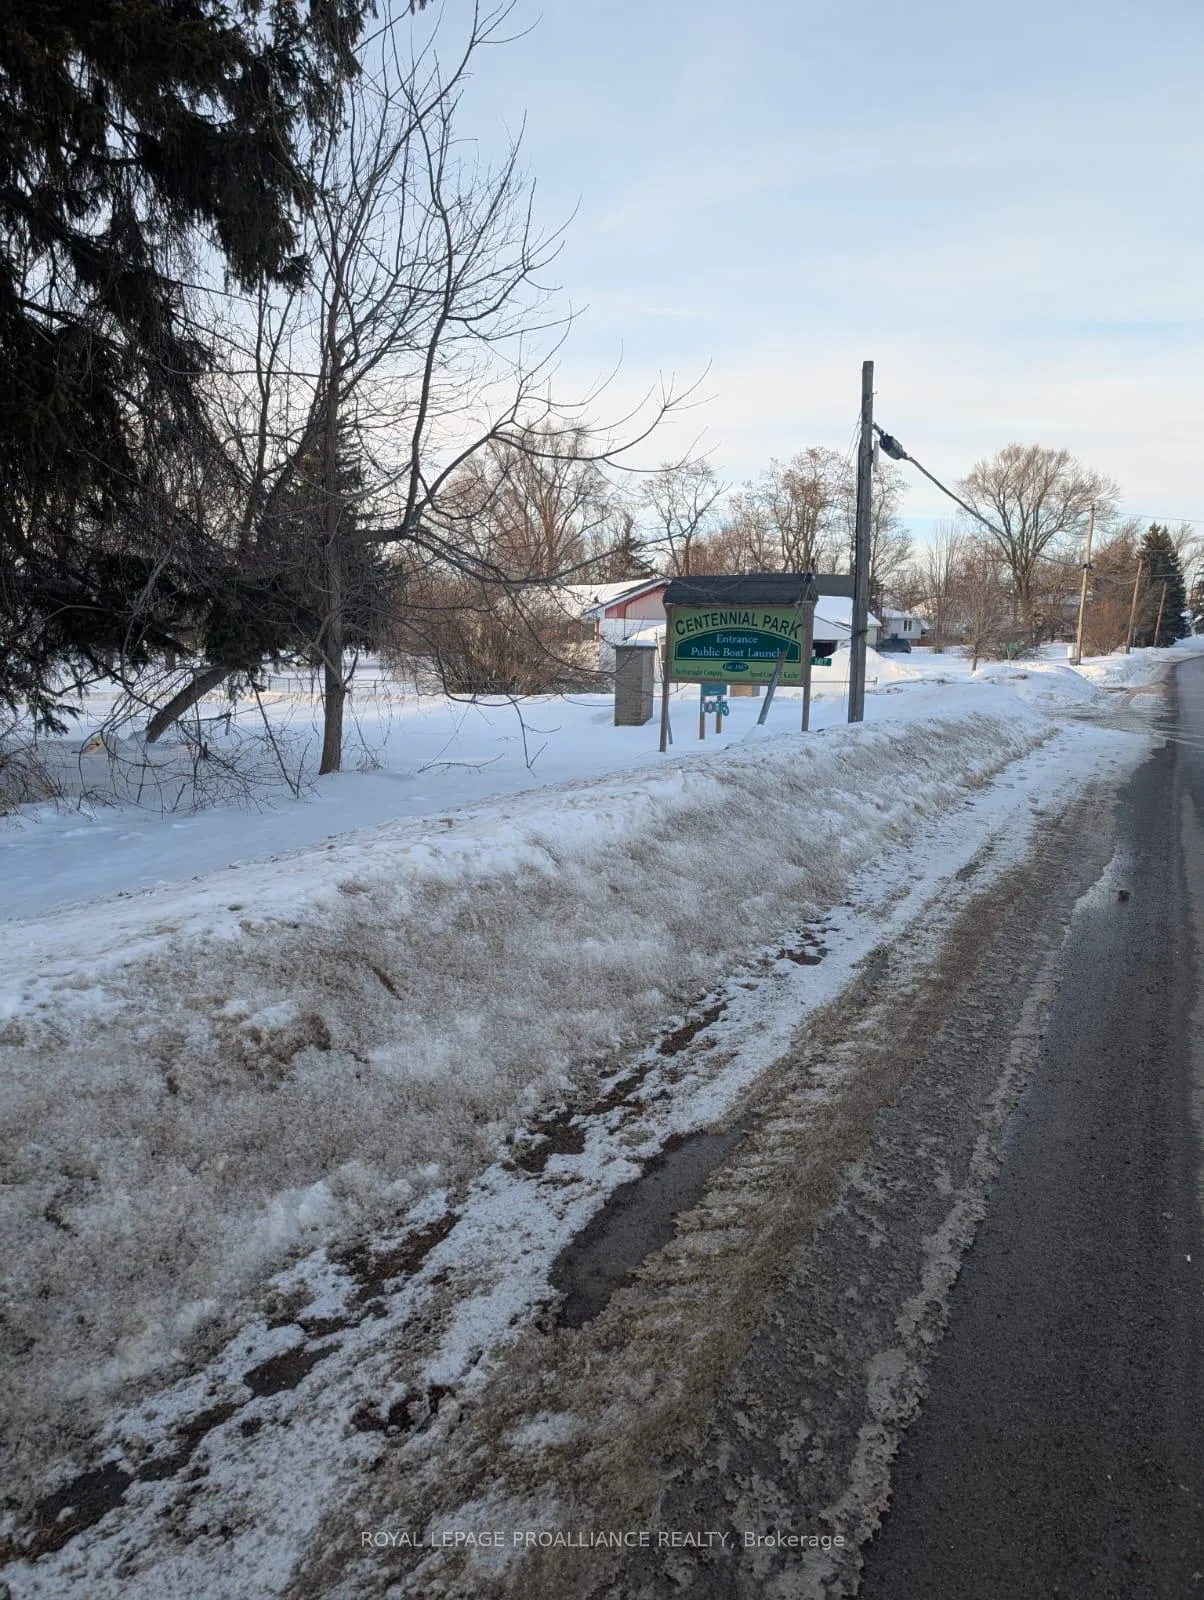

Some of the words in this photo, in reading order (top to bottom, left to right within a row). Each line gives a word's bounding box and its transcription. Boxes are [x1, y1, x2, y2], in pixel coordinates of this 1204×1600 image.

[675, 611, 758, 636] CENTENNIAL
[762, 614, 802, 639] PARK
[716, 633, 758, 644] Entrance
[690, 646, 720, 657] Public
[722, 646, 744, 657] Boat
